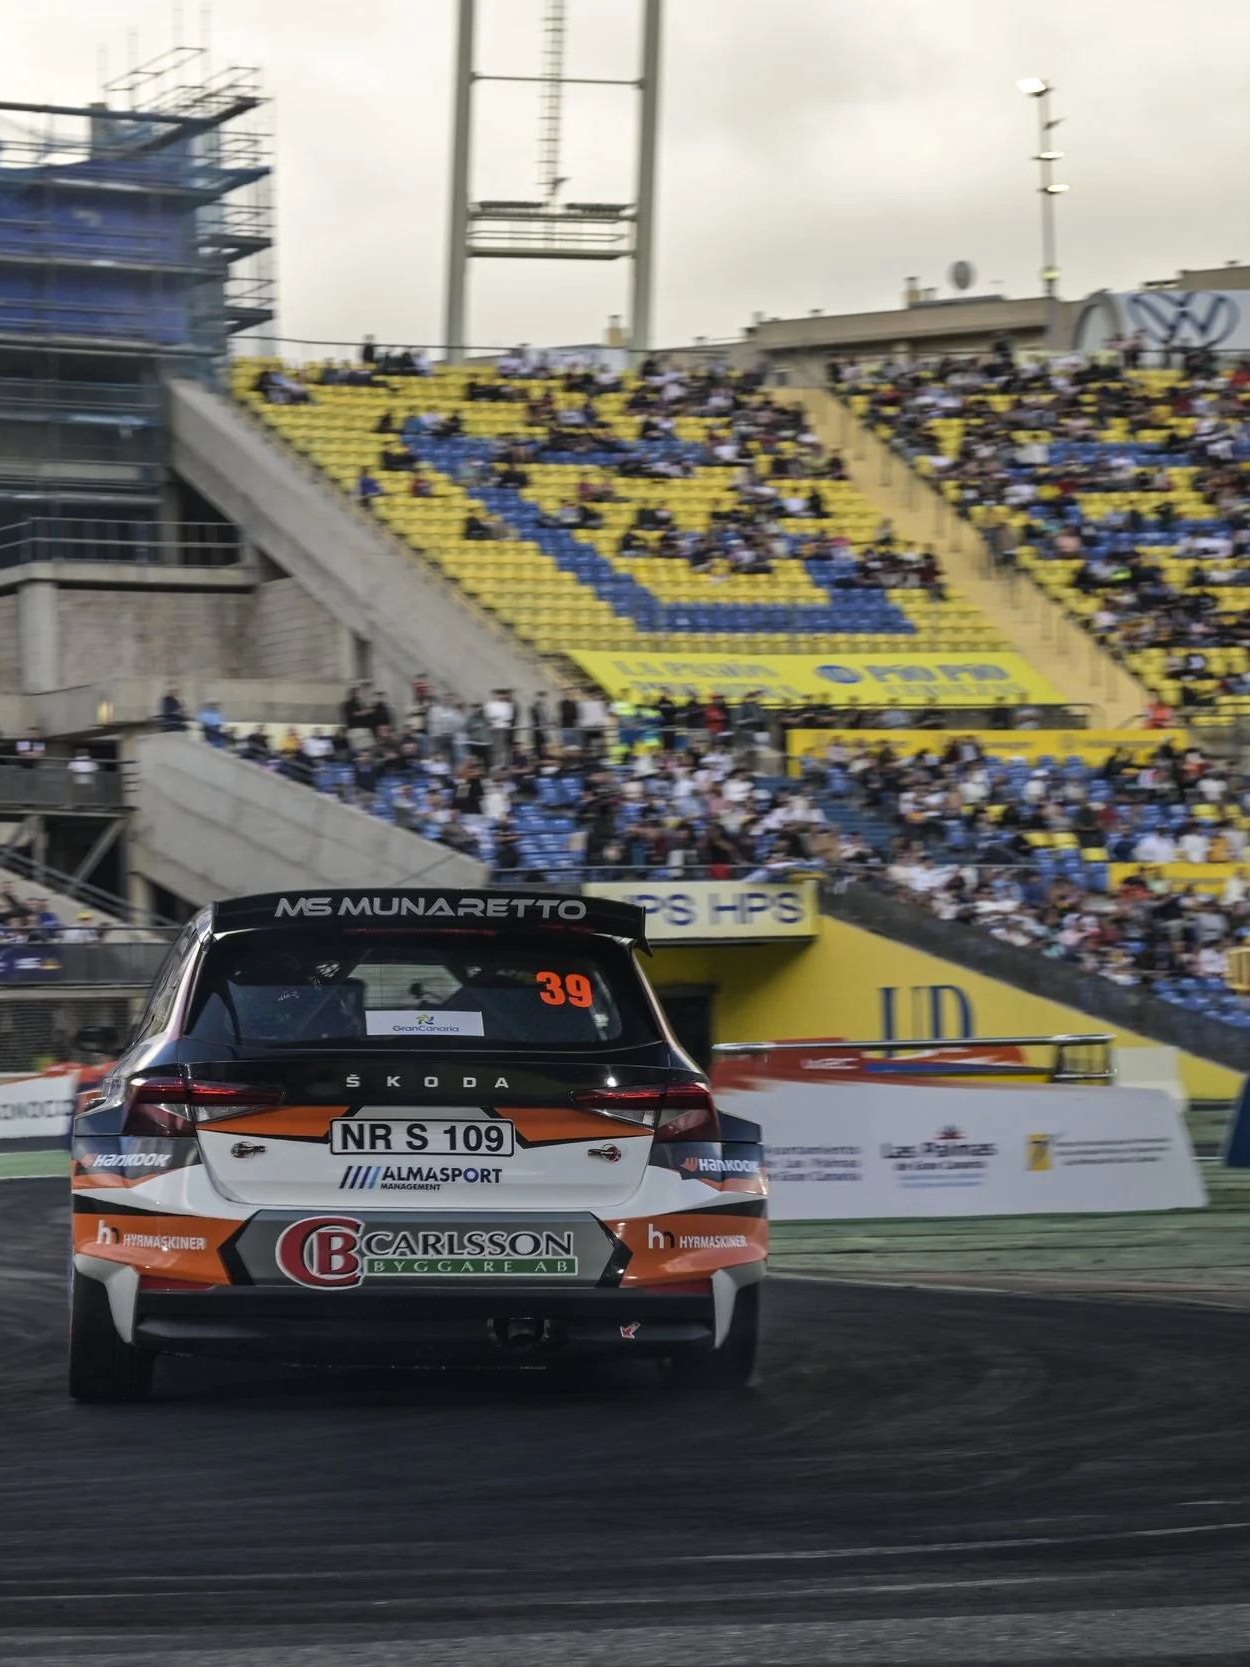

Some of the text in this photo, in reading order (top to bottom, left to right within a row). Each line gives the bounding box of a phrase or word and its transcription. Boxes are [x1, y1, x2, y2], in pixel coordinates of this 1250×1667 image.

[274, 897, 587, 920] MS MUNARETTO
[709, 892, 803, 925] HPS
[535, 971, 593, 1008] 39
[345, 1074, 509, 1088] ŠKODA
[340, 1123, 504, 1152] NR S 109
[765, 1146, 861, 1155] yuntamiento
[381, 1167, 502, 1184] ALMASPORT
[381, 1183, 440, 1191] MANAGEMENT
[123, 1234, 207, 1250] HYRMASKINER
[363, 1231, 574, 1257] CARLSSON
[679, 1235, 748, 1248] HYRMASKINER
[374, 1261, 567, 1273] BYGGARE AB
